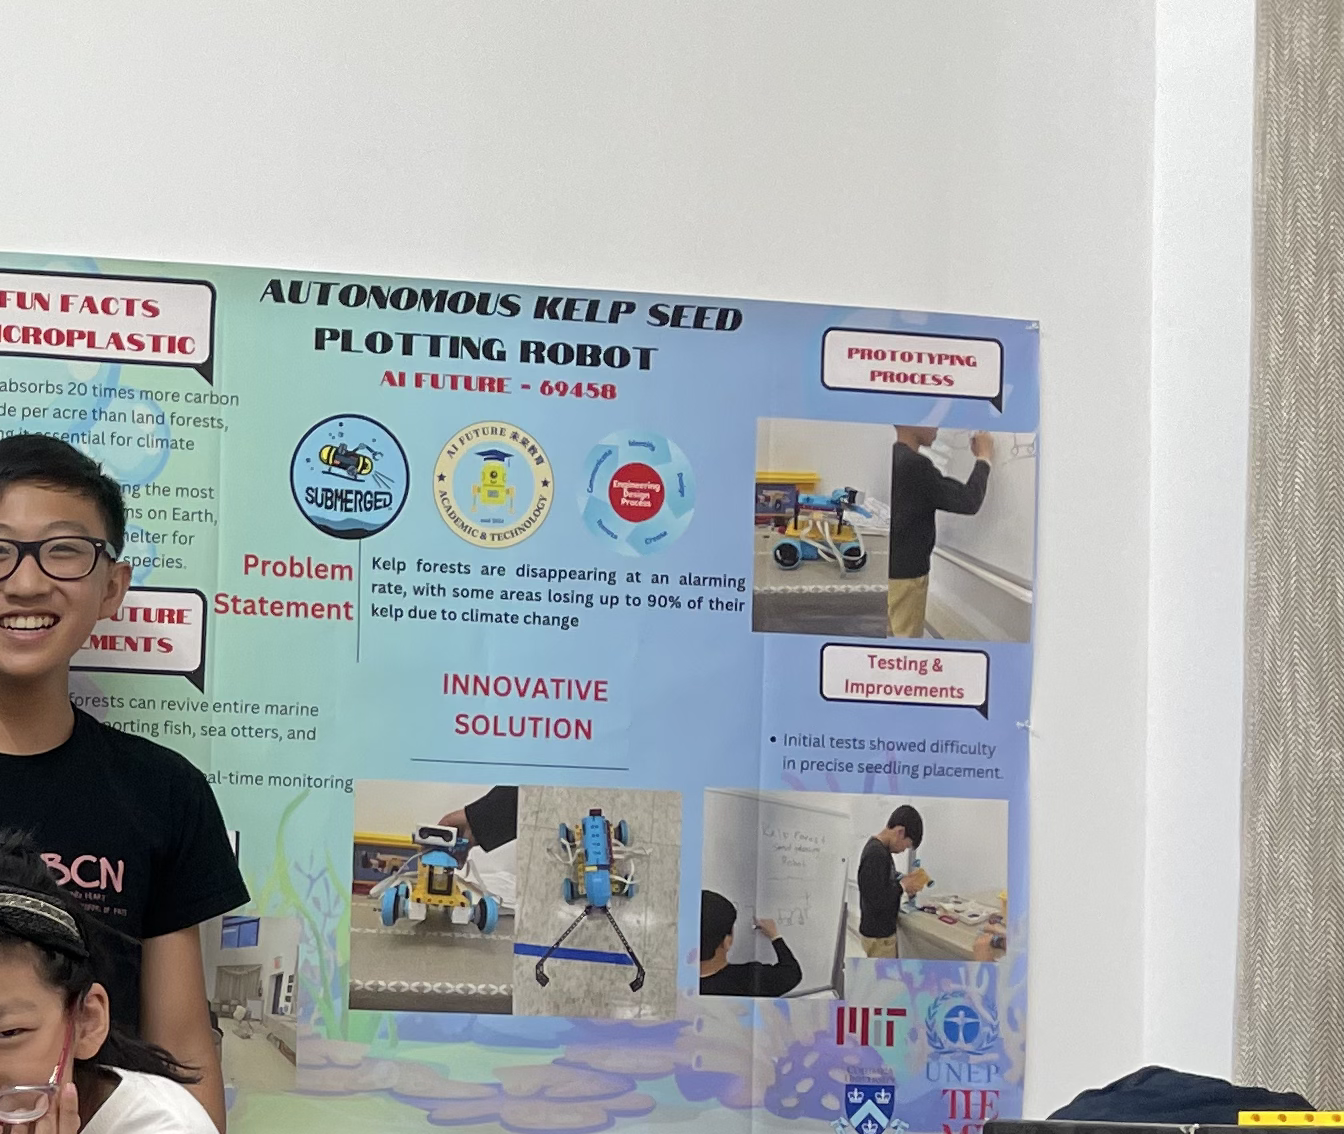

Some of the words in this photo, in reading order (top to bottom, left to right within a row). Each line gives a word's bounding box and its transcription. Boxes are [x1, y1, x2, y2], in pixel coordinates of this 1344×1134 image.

[60, 294, 160, 318] FACTS
[259, 278, 521, 317] AUTONOMOUS
[533, 296, 636, 327] KELP
[647, 302, 743, 332] SEED
[314, 327, 506, 362] PLOTTING
[519, 340, 659, 371] ROBOT
[847, 346, 978, 368] PROTOTYPING
[381, 369, 408, 388] AI
[414, 371, 512, 394] FUTURE
[539, 378, 618, 400] 69458
[869, 370, 955, 387] PROCESS
[68, 383, 87, 396] 20
[92, 384, 134, 400] times
[140, 390, 180, 402] more
[184, 391, 239, 406] carbon
[21, 406, 48, 420] per
[53, 408, 87, 420] acre
[92, 408, 126, 423] than
[131, 411, 165, 426] land
[170, 413, 229, 431] forests,
[110, 432, 132, 447] for
[137, 434, 195, 451] climate
[459, 426, 507, 447] FUTURE
[145, 482, 171, 497] the
[175, 485, 214, 499] most
[304, 486, 394, 514] SUBMERGED
[147, 509, 167, 520] on
[172, 508, 218, 526] Earth,
[439, 489, 480, 538] ACADEMIC
[490, 494, 548, 542] TECHNOLOGY
[172, 530, 195, 546] for
[123, 554, 187, 571] species.
[243, 554, 354, 581] Problem
[372, 556, 406, 574] Kelp
[417, 559, 471, 576] forests
[480, 565, 506, 577] are
[515, 563, 617, 585] disappearing
[625, 570, 642, 583] at
[651, 573, 670, 585] an
[679, 572, 746, 592] alarming
[214, 593, 354, 621] Statement
[371, 582, 408, 598] rate,
[412, 582, 446, 598] with
[452, 588, 494, 600] some
[500, 590, 542, 603] areas
[547, 589, 594, 607] losing
[599, 594, 620, 609] up
[625, 594, 642, 607] to
[647, 594, 682, 609] 90%
[687, 596, 704, 610] of
[708, 596, 745, 612] their
[371, 604, 404, 620] kelp
[408, 605, 437, 620] due
[441, 608, 457, 621] to
[461, 608, 520, 624] climate
[523, 612, 579, 629] change
[867, 654, 929, 675] Testing
[932, 657, 944, 673] &
[442, 673, 609, 702] INNOVATIVE
[844, 678, 965, 700] Improvements
[129, 696, 157, 710] can
[161, 696, 209, 713] revive
[213, 699, 260, 715] entire
[264, 700, 319, 717] marine
[164, 719, 196, 738] fish,
[200, 724, 227, 737] sea
[231, 725, 283, 742] otters,
[287, 726, 316, 741] and
[454, 713, 593, 741] SOLUTION
[783, 733, 825, 749] Initial
[829, 737, 866, 750] tests
[869, 738, 926, 753] showed
[930, 740, 997, 759] difficulty
[783, 756, 796, 770] in
[800, 758, 854, 774] precise
[858, 761, 919, 778] seedling
[923, 764, 1004, 780] placement.
[268, 773, 354, 793] monitoring
[40, 852, 124, 893] BCN
[836, 1007, 907, 1047] MIT
[926, 1062, 999, 1083] UNEP
[941, 1089, 1000, 1121] THE
